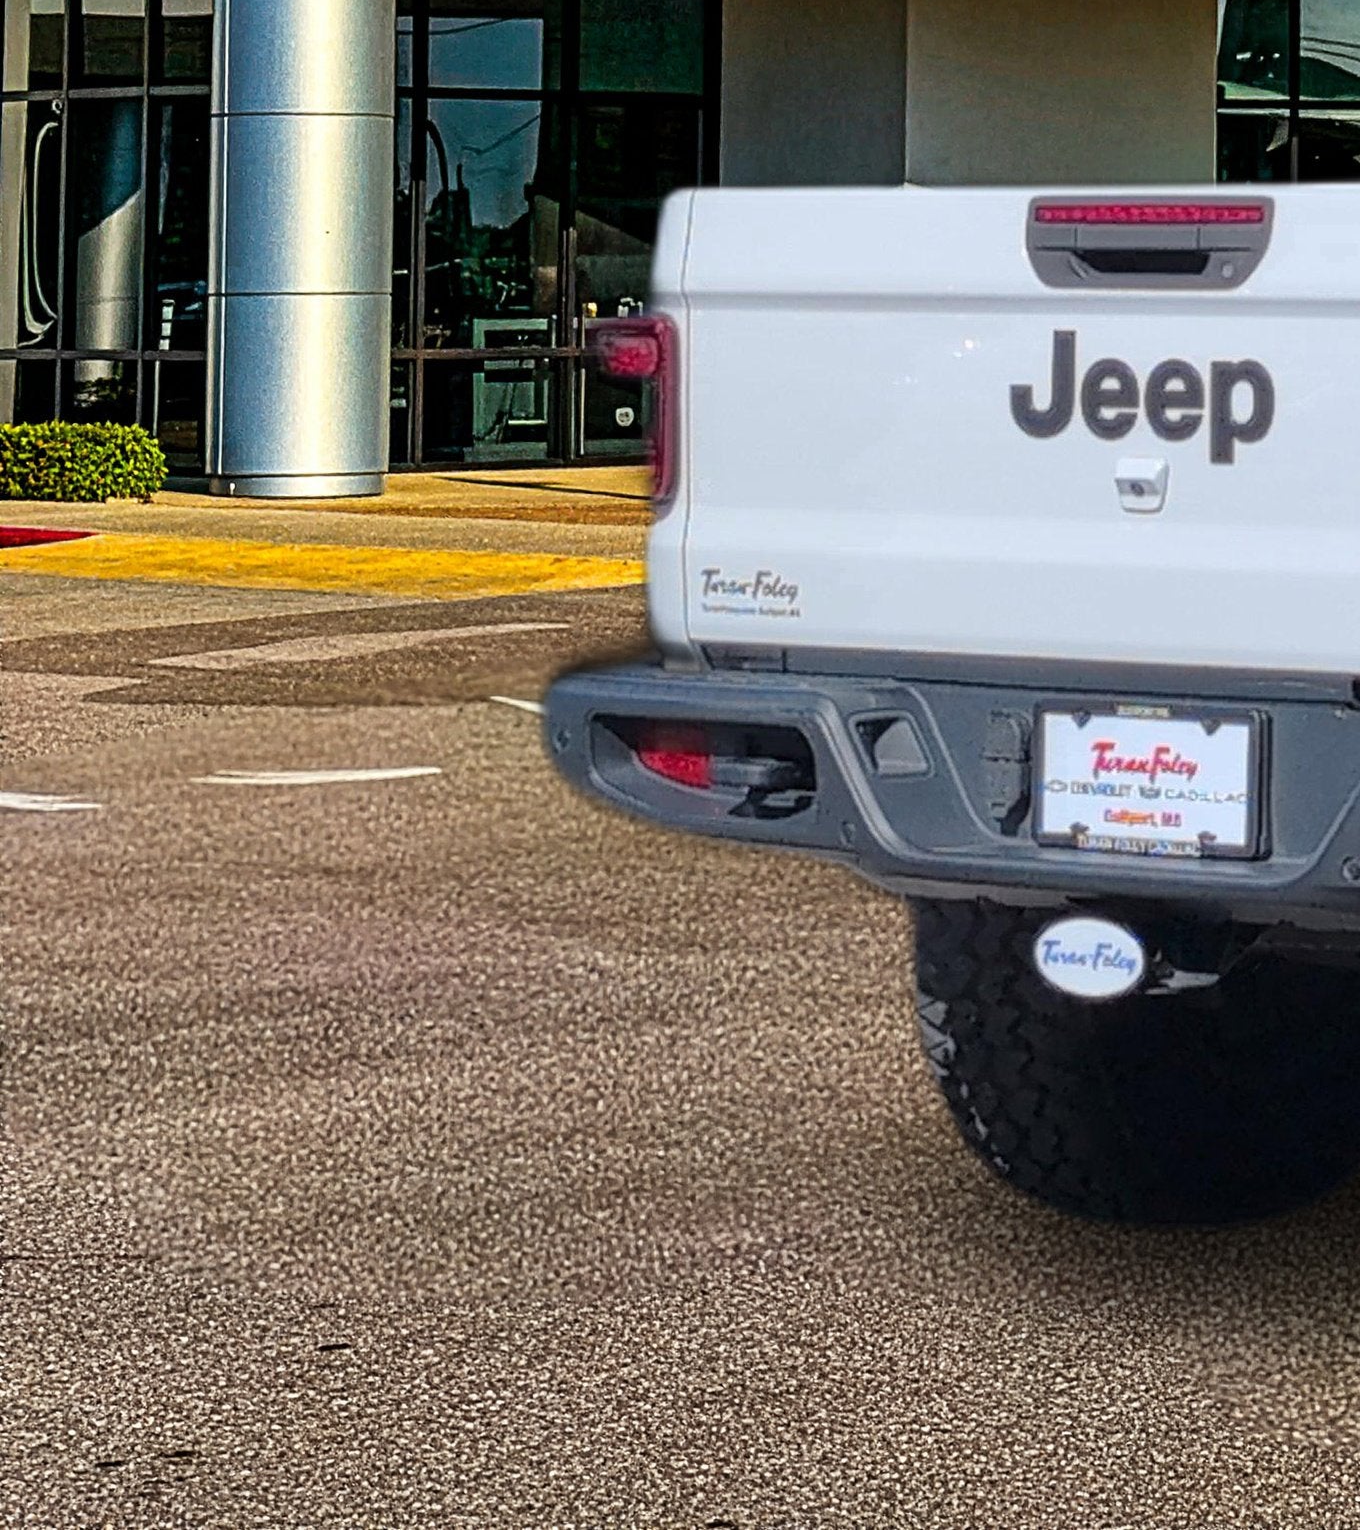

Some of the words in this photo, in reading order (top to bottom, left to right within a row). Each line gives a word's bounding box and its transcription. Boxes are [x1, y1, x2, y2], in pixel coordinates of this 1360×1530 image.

[1008, 329, 1276, 466] Jeep
[752, 570, 799, 603] Foley
[1148, 745, 1199, 785] Foley
[1089, 942, 1138, 975] Foley
